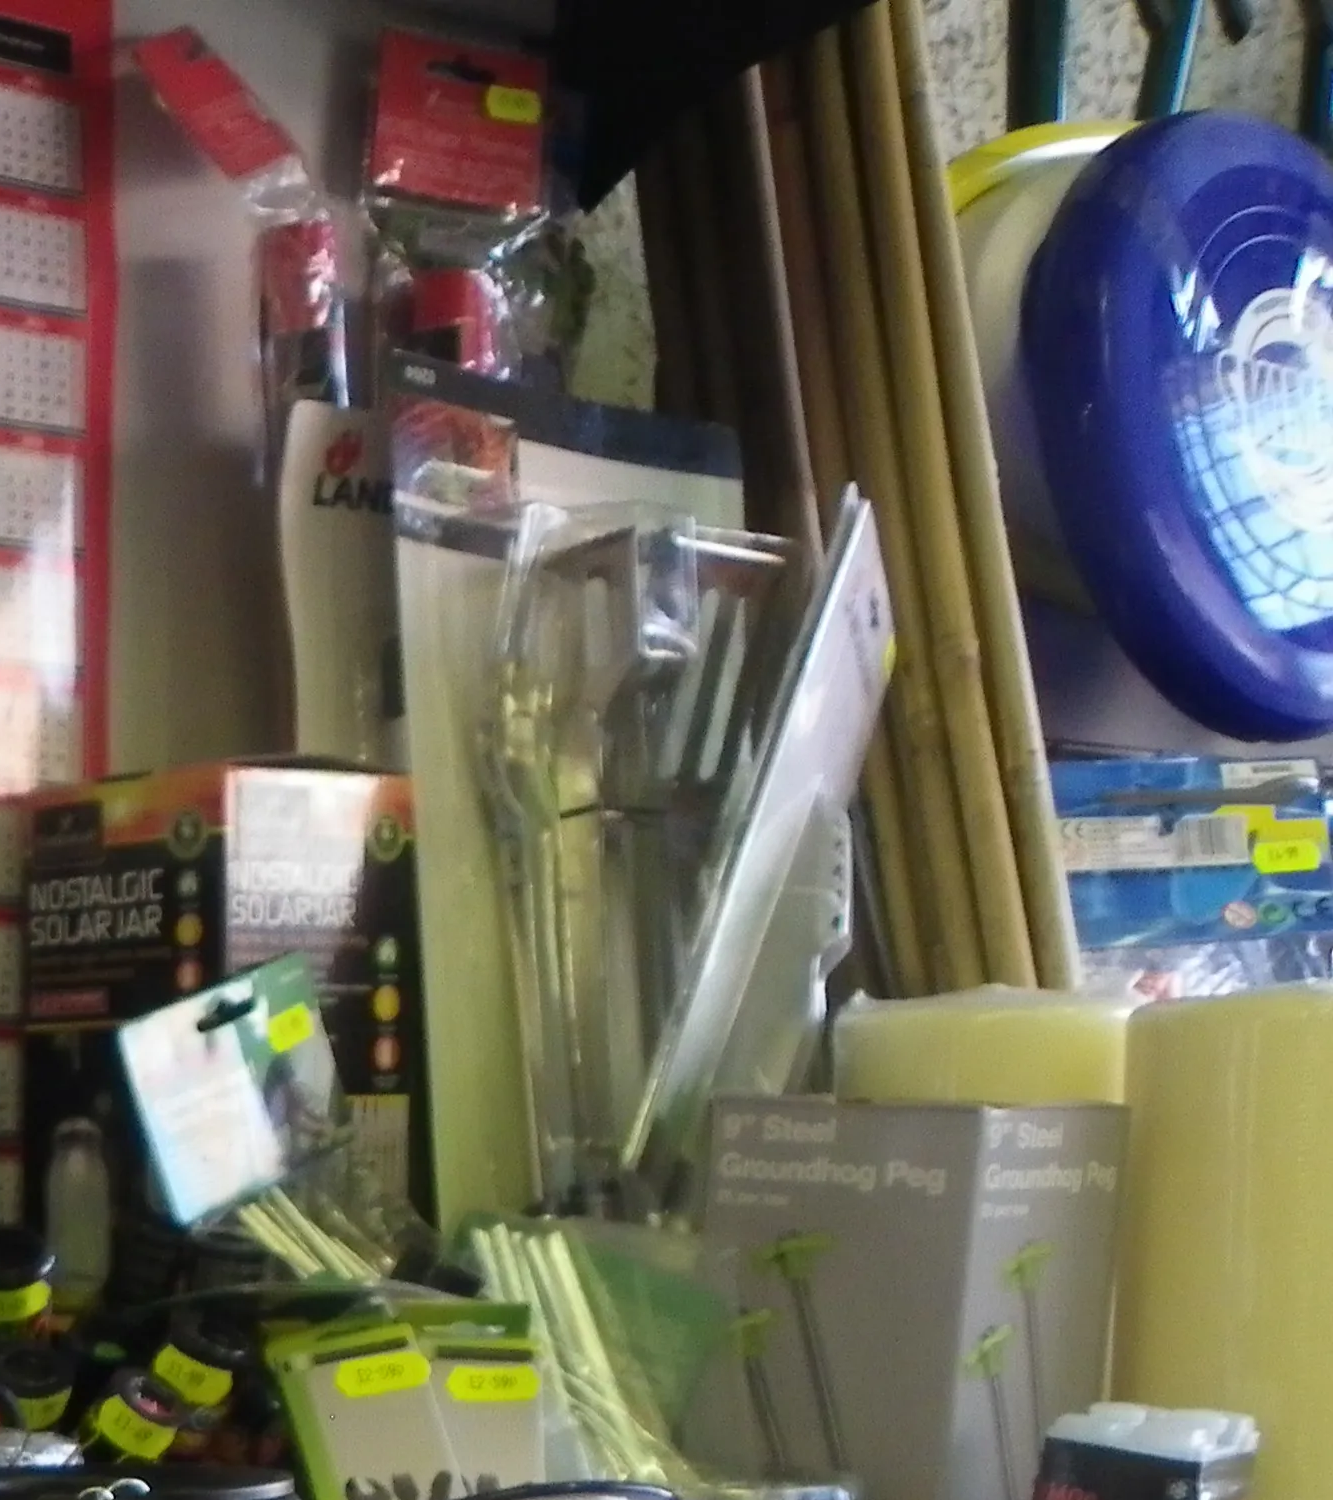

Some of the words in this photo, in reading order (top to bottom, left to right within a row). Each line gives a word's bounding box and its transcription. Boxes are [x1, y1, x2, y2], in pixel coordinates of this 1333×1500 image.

[31, 868, 165, 911] NOSTALGIC
[31, 911, 112, 946] SOLAR
[719, 1152, 877, 1192] Groundhog
[886, 1159, 945, 1197] Peg
[983, 1161, 1083, 1193] Groundhog
